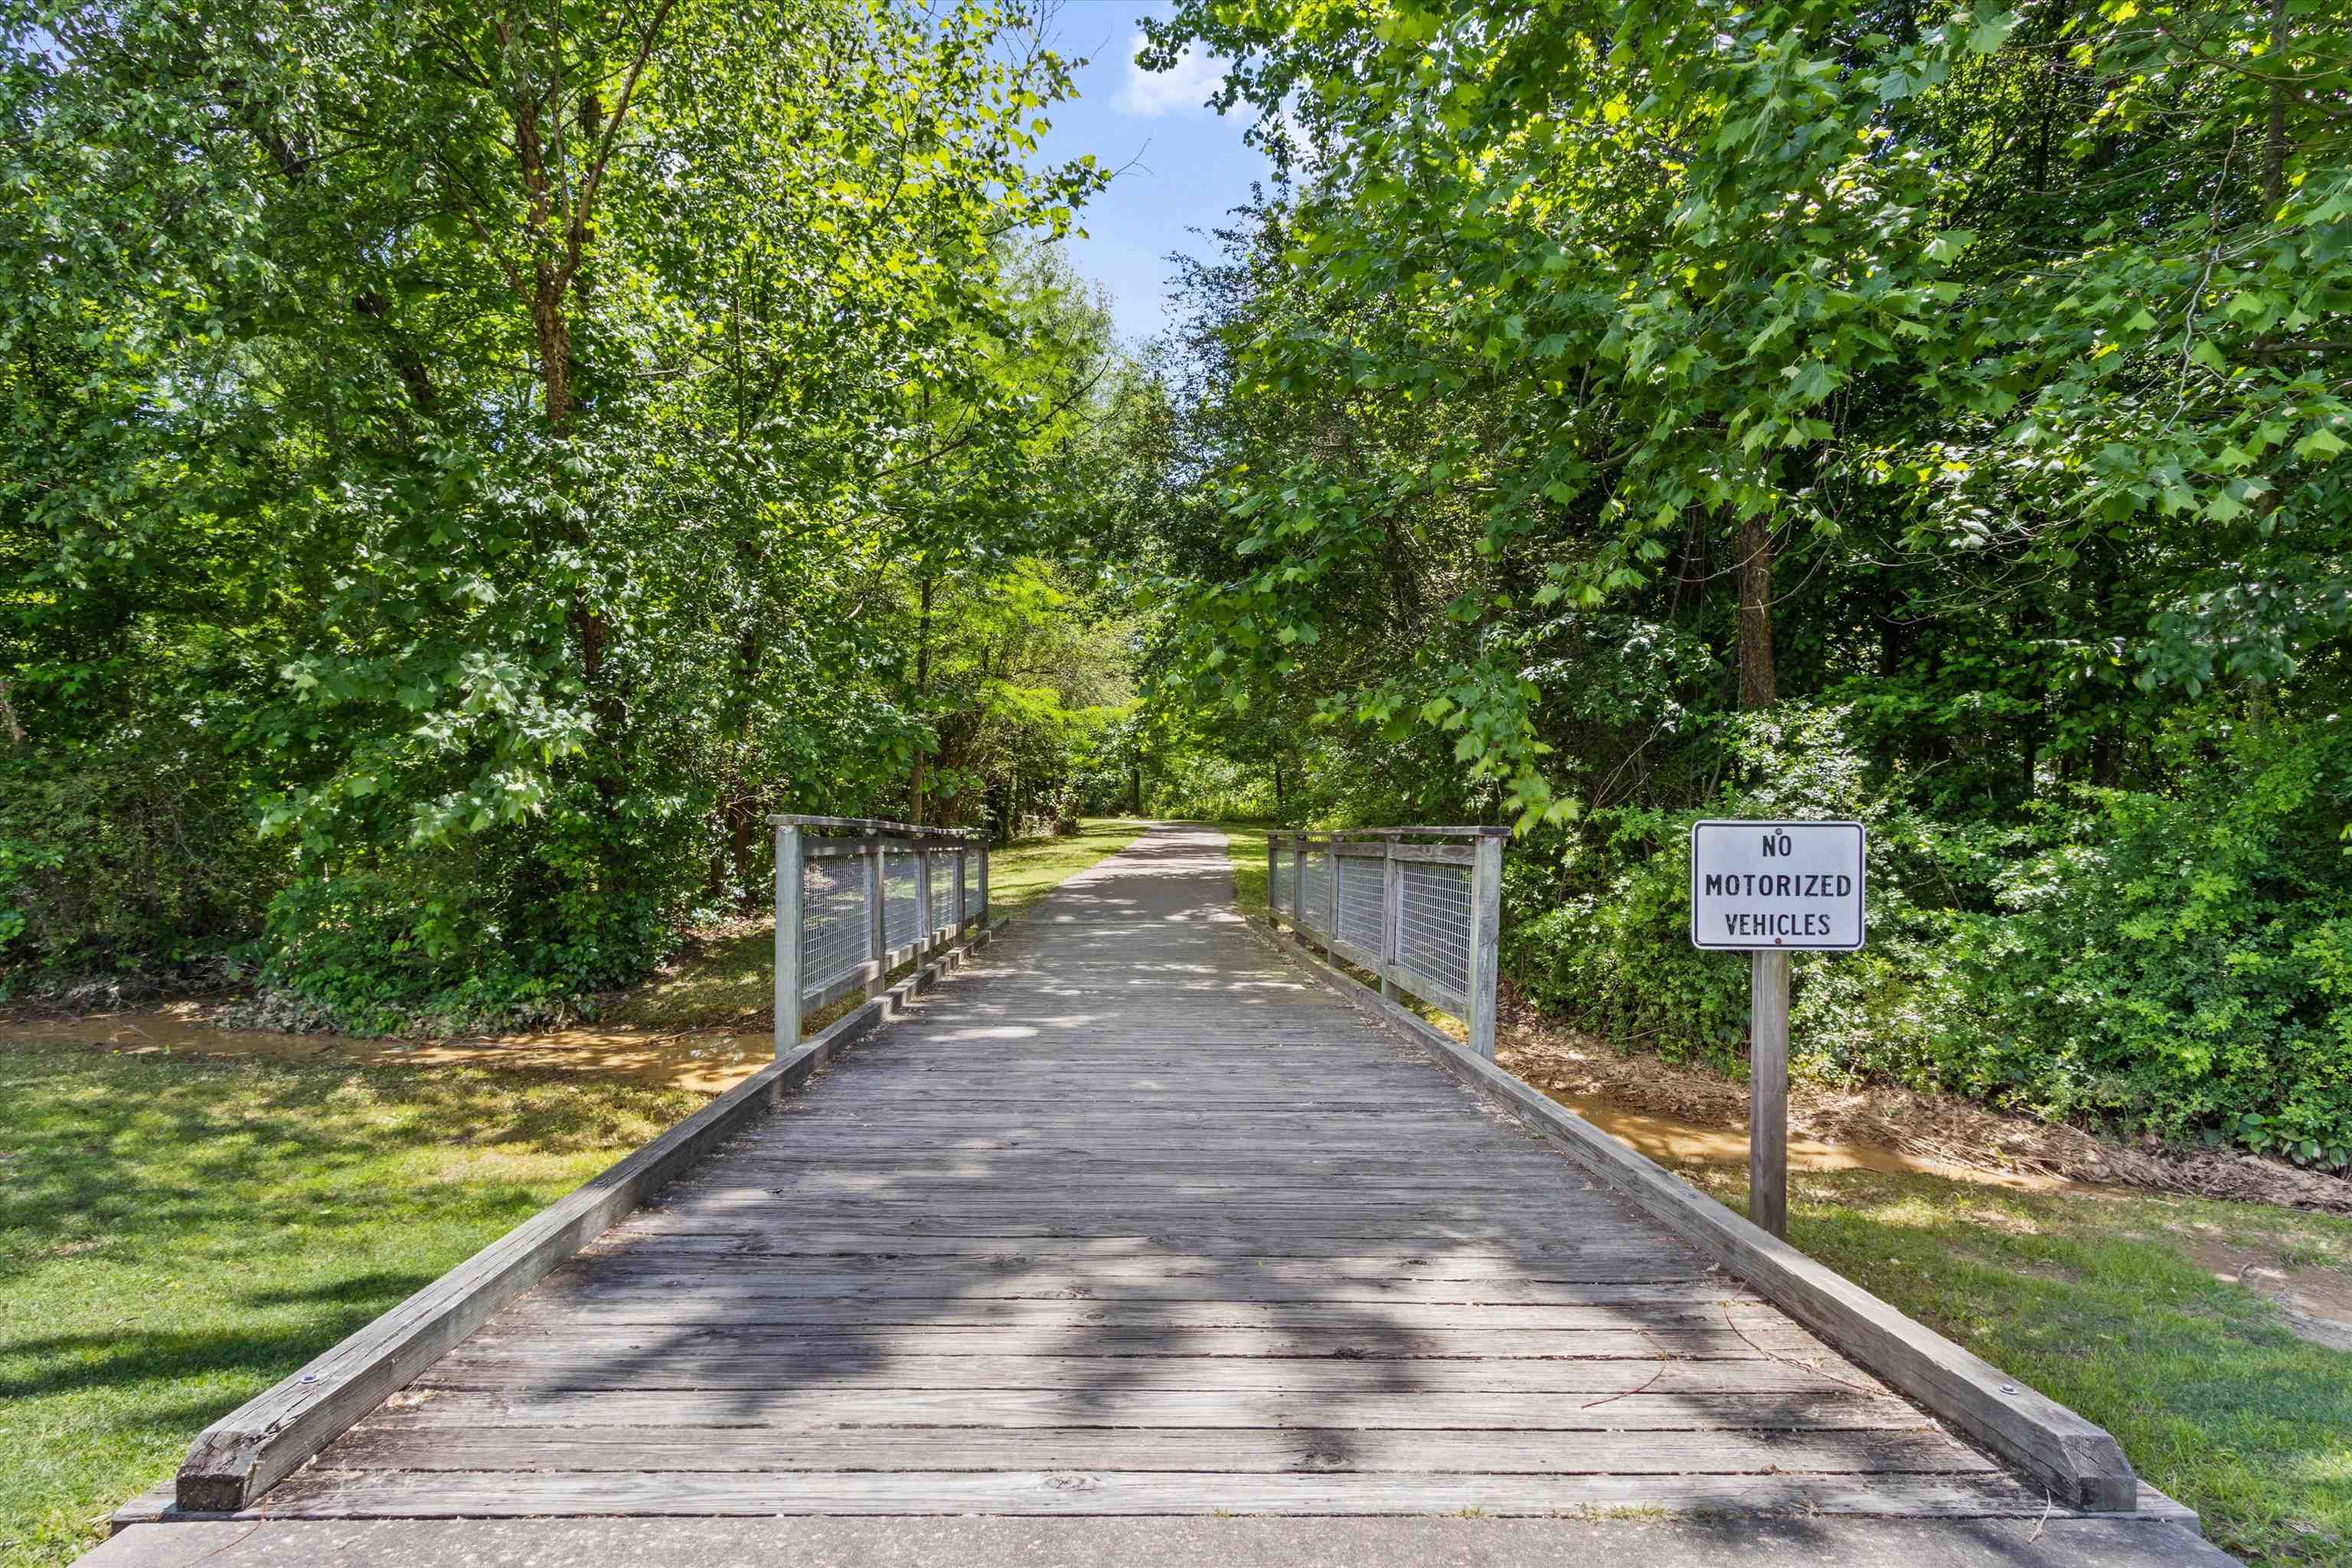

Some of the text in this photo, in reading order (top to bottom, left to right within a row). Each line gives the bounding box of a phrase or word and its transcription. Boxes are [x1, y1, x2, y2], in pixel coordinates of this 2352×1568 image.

[1762, 835, 1792, 857] NO
[1705, 874, 1852, 897] MOTORIZED
[1724, 913, 1831, 936] VEHICLES
